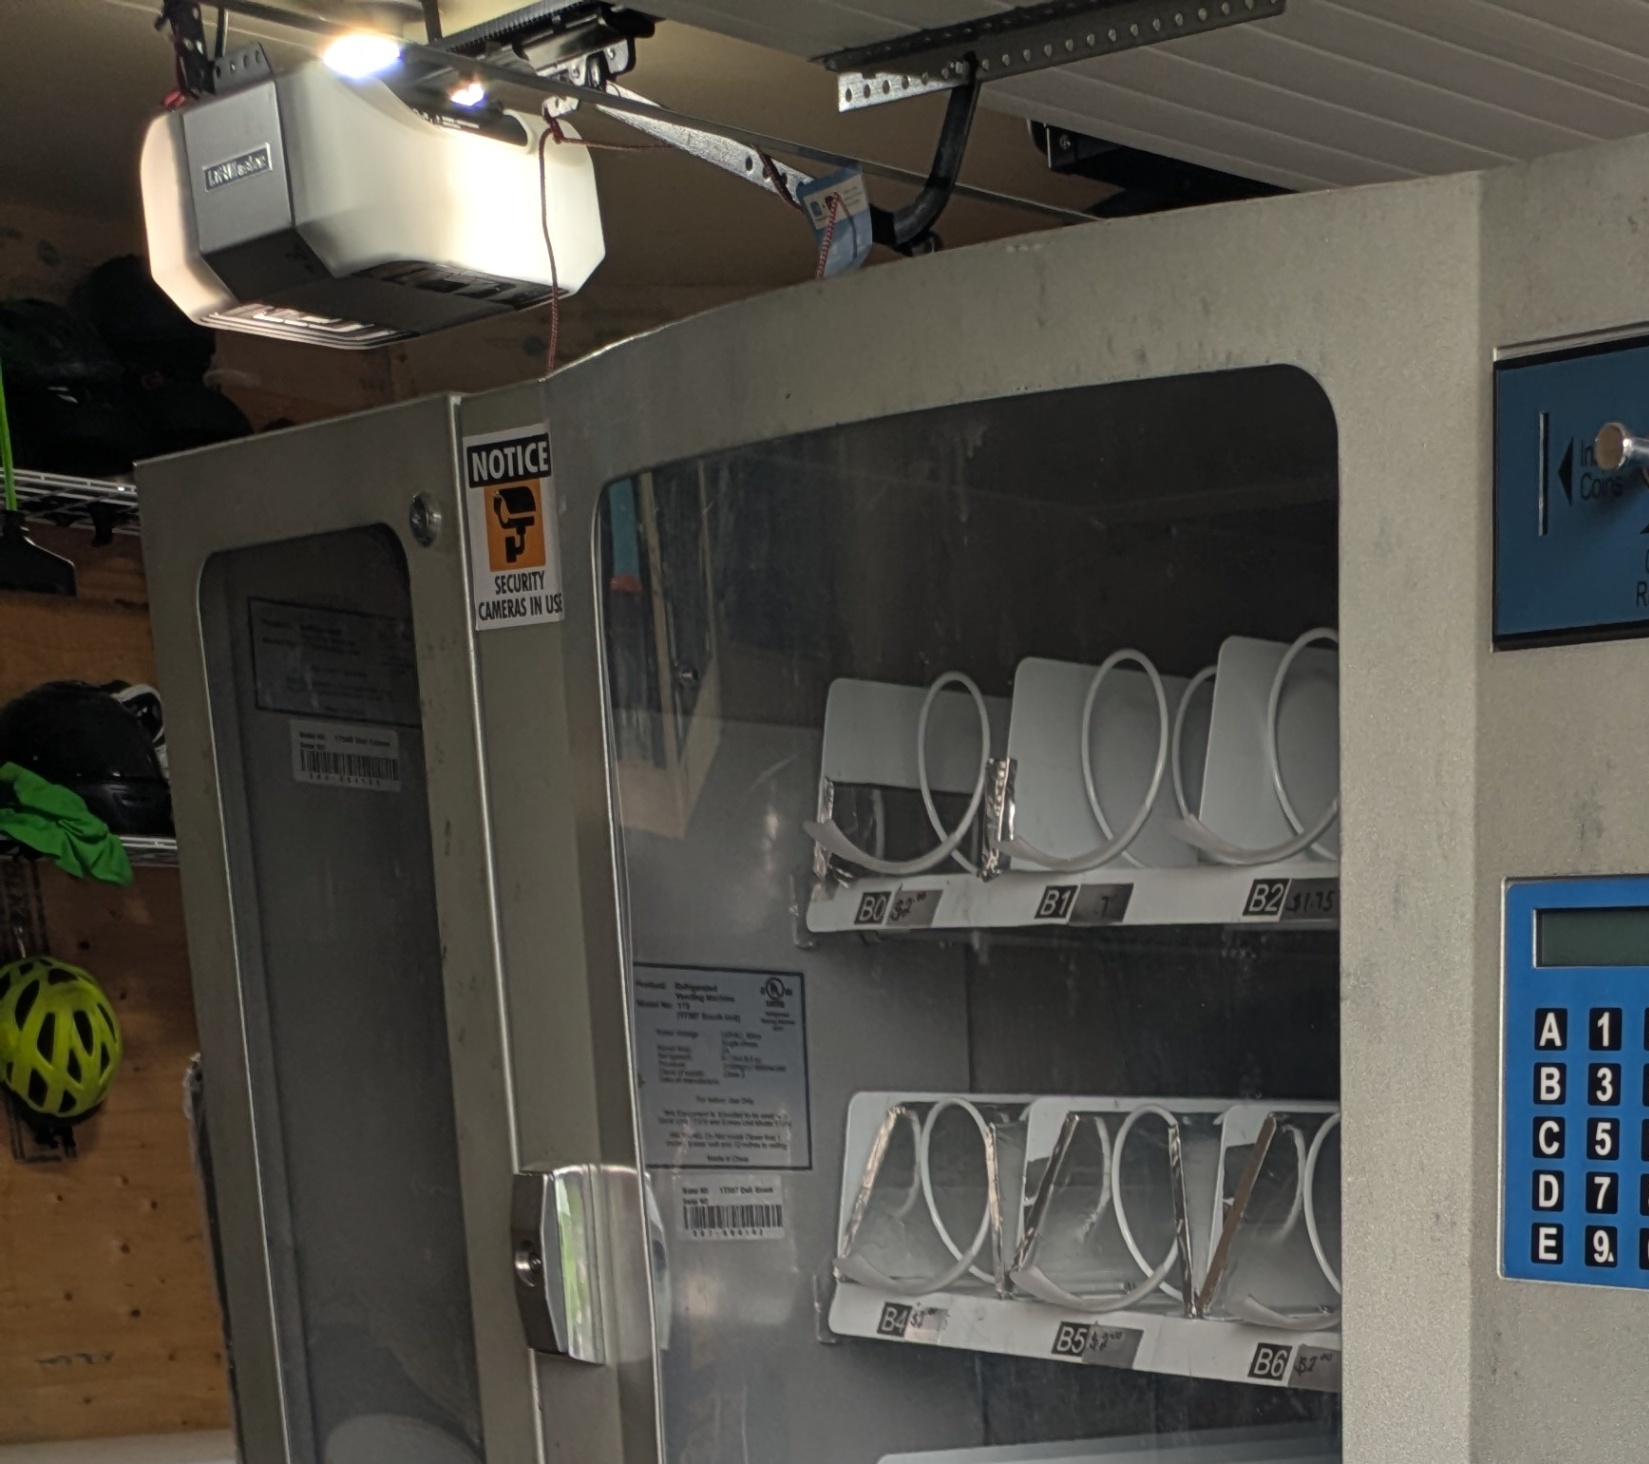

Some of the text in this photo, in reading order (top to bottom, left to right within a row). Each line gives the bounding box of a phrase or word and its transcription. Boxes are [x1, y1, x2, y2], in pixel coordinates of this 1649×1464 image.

[472, 441, 548, 482] NOTICE
[1580, 472, 1623, 500] Coins
[495, 571, 544, 595] SECURITY
[479, 597, 526, 621] CAMERAS
[529, 596, 542, 616] IN
[859, 894, 886, 921] B0
[1040, 889, 1070, 916] B1
[1249, 884, 1284, 912] B2
[1539, 1013, 1562, 1047] A
[1597, 1012, 1610, 1046] 1
[1540, 1067, 1561, 1101] B
[1596, 1067, 1612, 1102] 3
[1539, 1121, 1559, 1155] C
[1595, 1122, 1612, 1156] 5
[1538, 1175, 1558, 1207] D
[1594, 1177, 1610, 1209] 7
[1539, 1228, 1557, 1260] E
[1593, 1230, 1608, 1263] 9
[881, 1307, 906, 1333] B4
[1056, 1326, 1087, 1354] B5
[1253, 1348, 1287, 1377] B6
